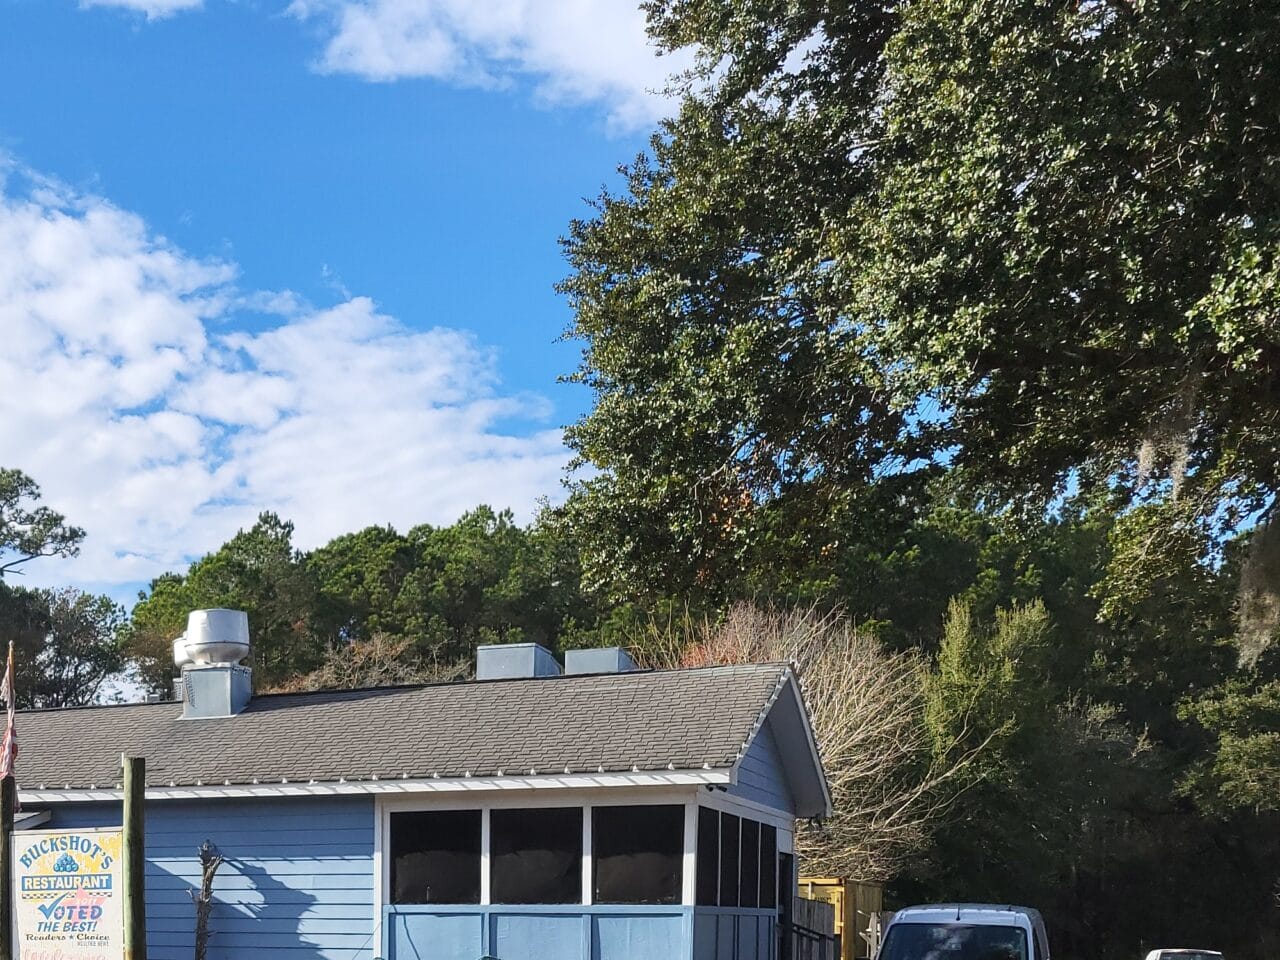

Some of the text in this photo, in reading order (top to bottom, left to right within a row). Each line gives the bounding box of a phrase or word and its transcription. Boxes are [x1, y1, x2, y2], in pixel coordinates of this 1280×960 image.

[20, 835, 113, 869] BUCKSHOT'S
[24, 874, 109, 890] RESTAURANT
[37, 921, 98, 932] THE BEST!
[76, 933, 110, 941] Choice
